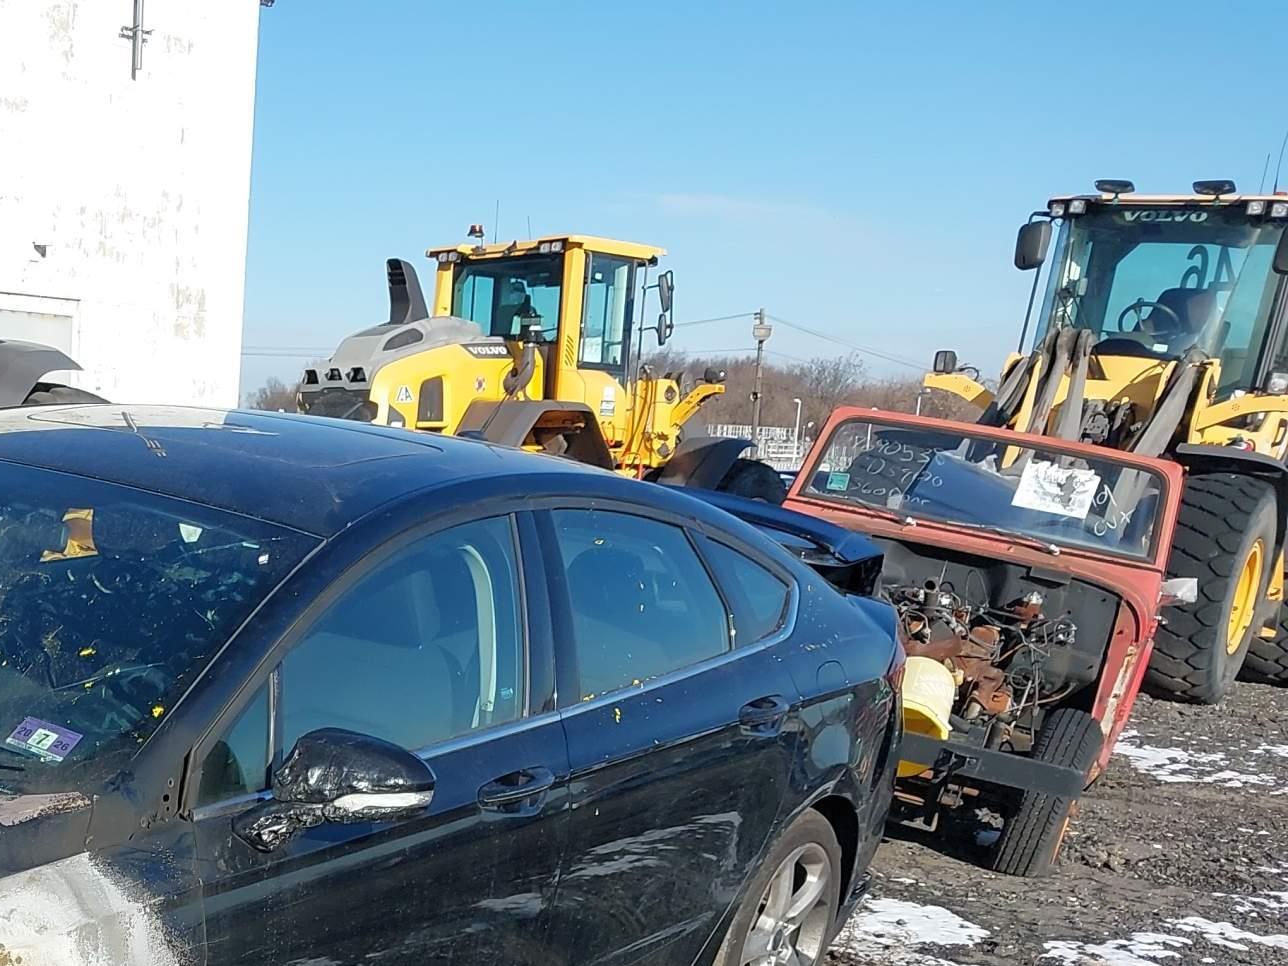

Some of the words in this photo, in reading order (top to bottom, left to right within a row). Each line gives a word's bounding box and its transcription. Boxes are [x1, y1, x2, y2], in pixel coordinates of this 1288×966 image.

[1122, 210, 1208, 222] VOLVO
[469, 346, 508, 355] VOLVO
[17, 727, 32, 737] 20
[37, 733, 50, 745] 7
[54, 741, 70, 751] 26
